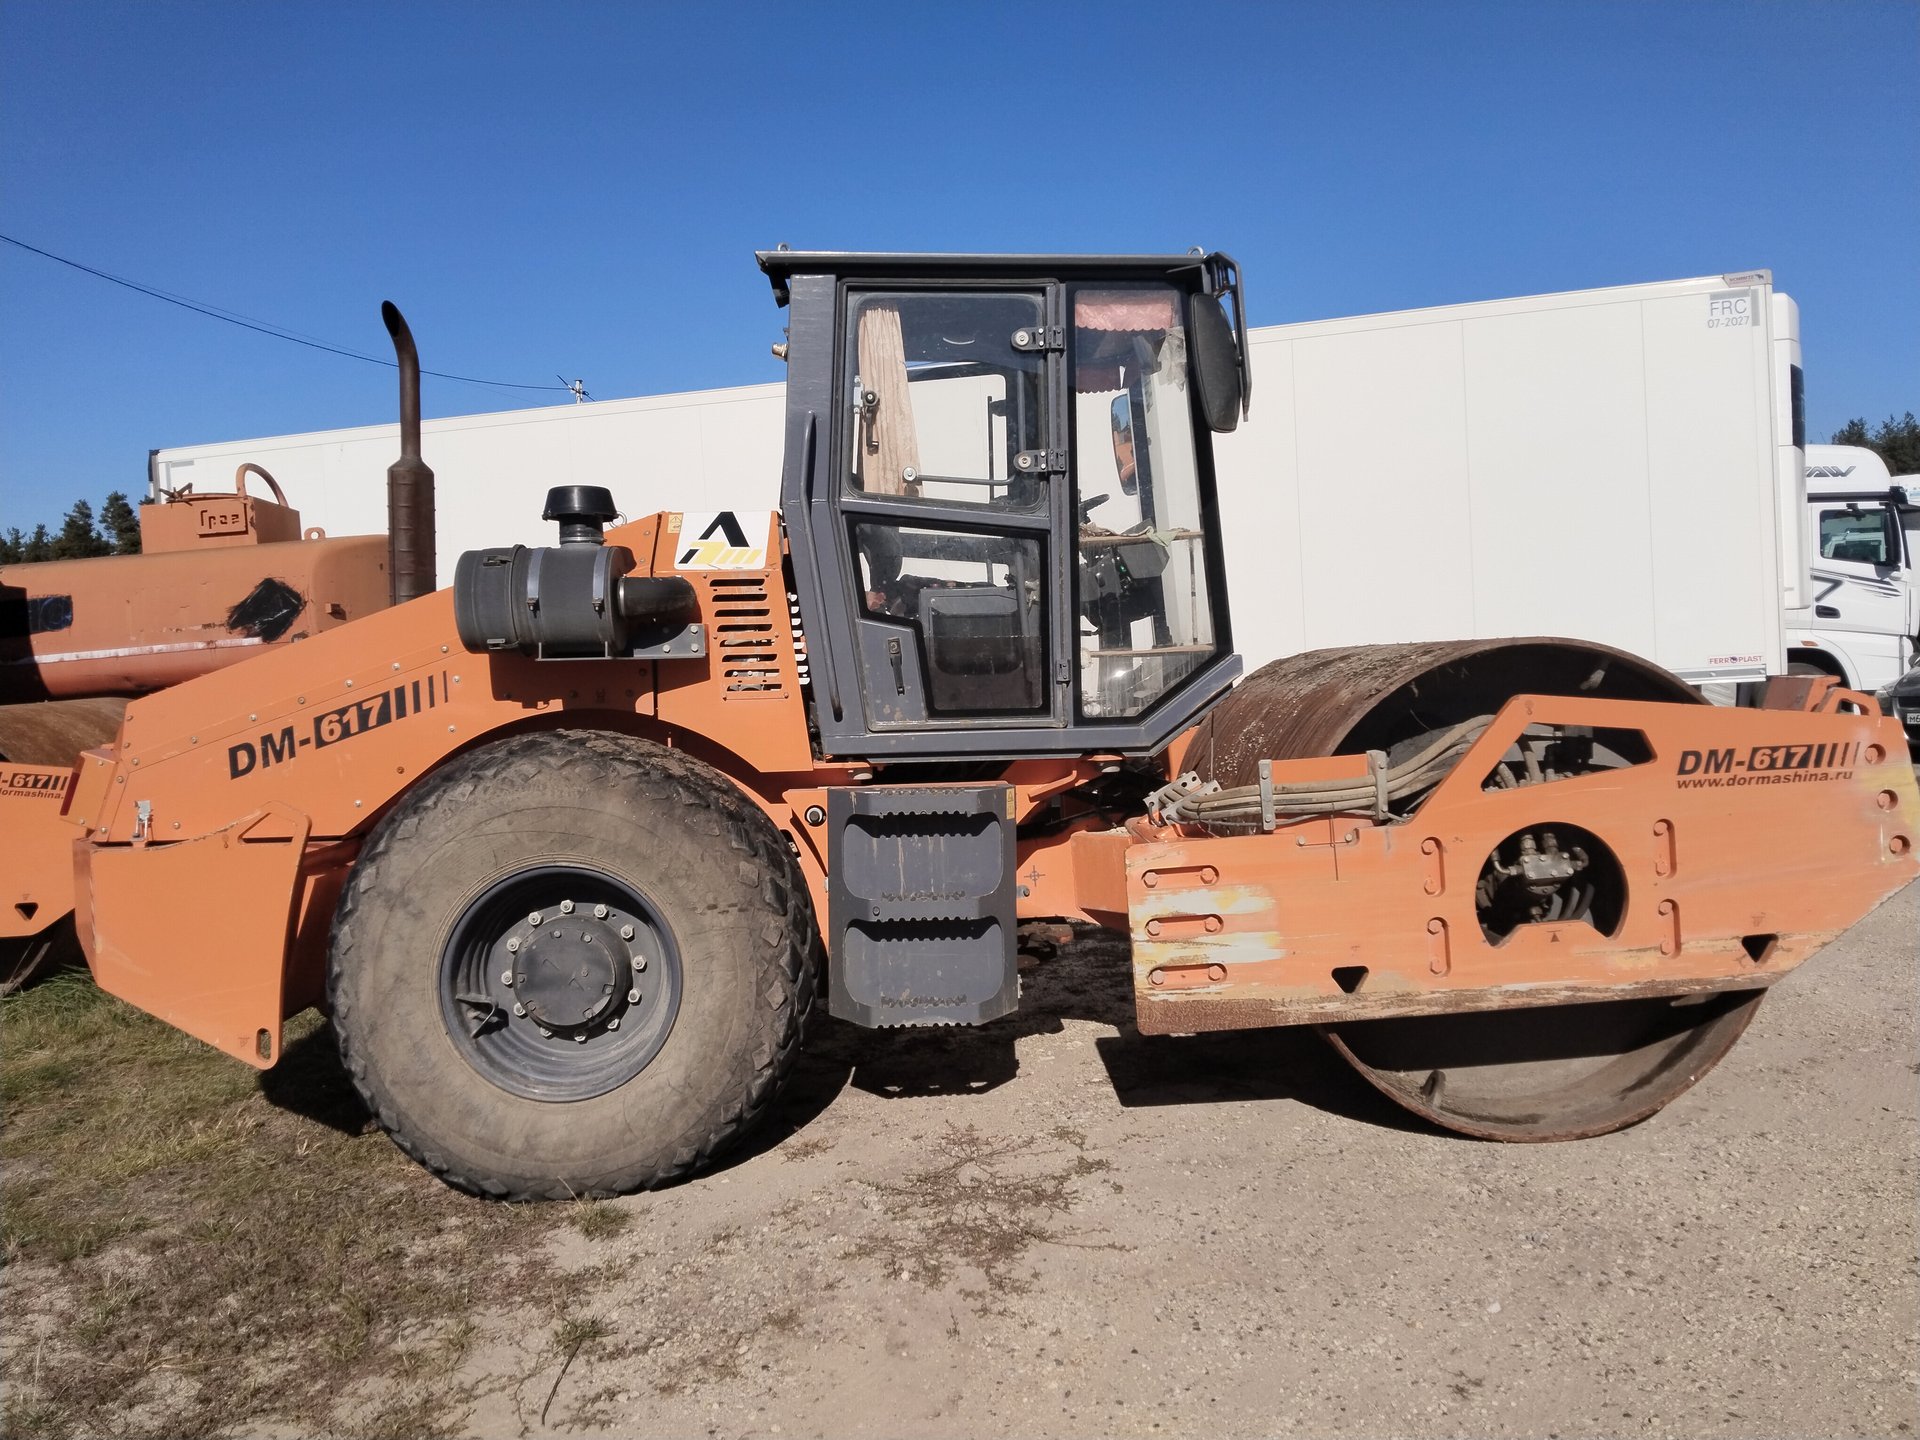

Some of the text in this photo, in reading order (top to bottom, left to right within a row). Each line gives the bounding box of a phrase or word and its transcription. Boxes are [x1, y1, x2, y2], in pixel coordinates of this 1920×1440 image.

[1710, 299, 1747, 316] FRC
[1707, 316, 1750, 328] 07-2027
[228, 694, 387, 780] DM-617
[1676, 745, 1811, 776] DM-617
[0, 772, 48, 788] -617
[1676, 770, 1853, 789] www.dormashina.ru
